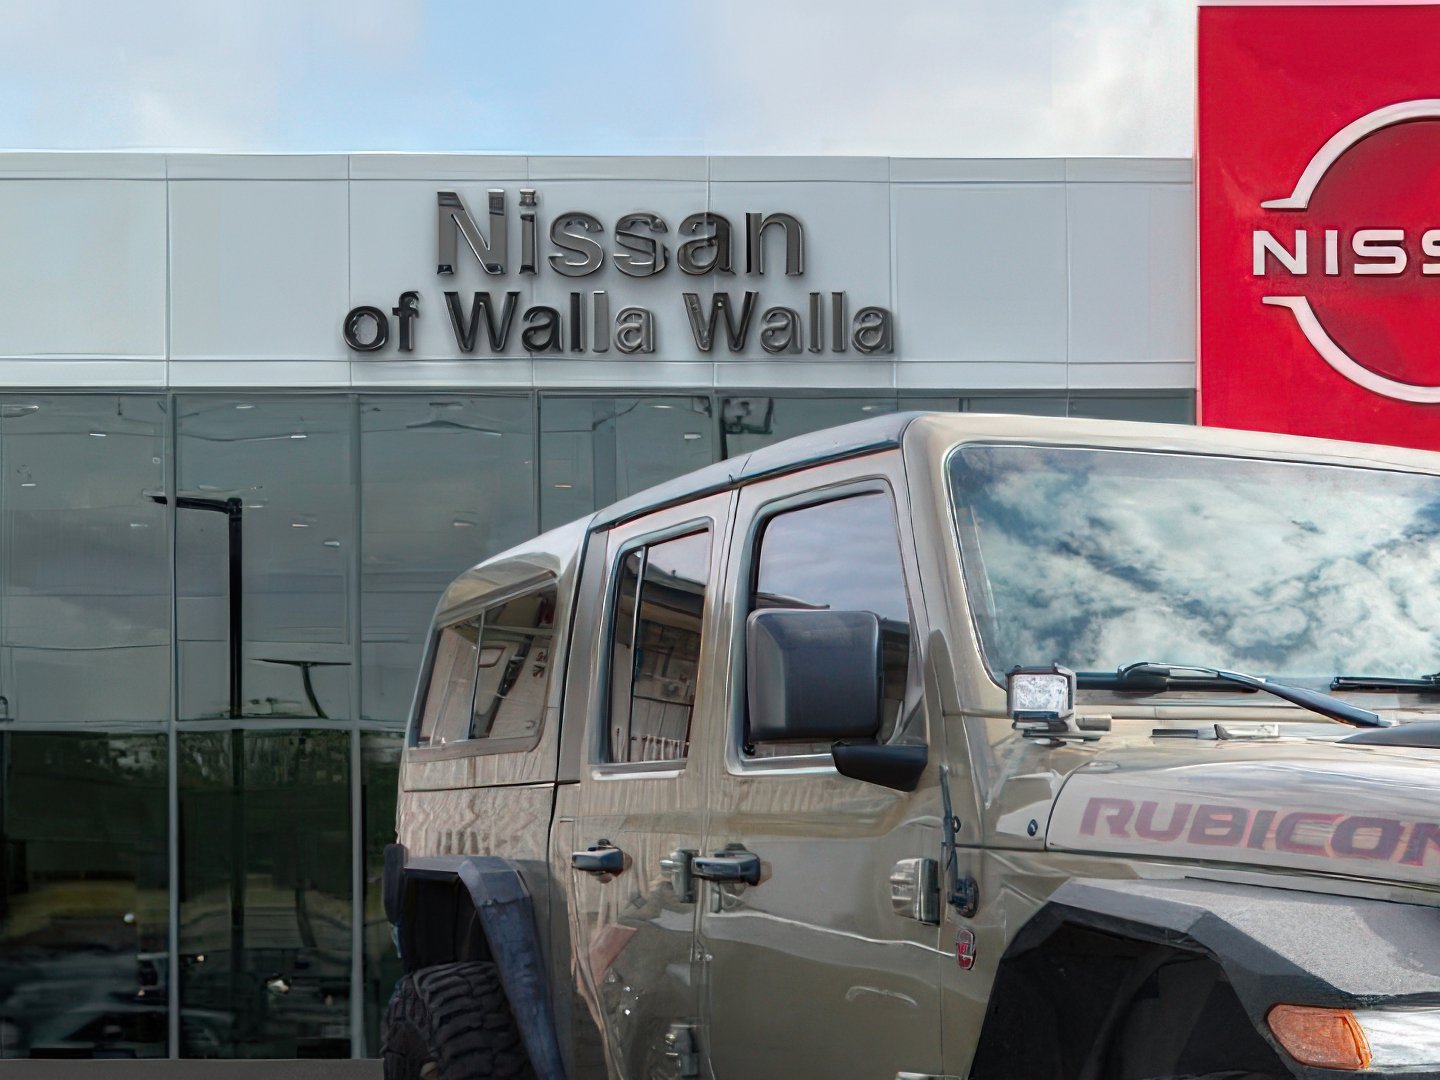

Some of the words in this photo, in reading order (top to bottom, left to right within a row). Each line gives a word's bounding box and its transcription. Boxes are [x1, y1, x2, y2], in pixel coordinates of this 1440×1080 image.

[436, 188, 804, 276] Nissan
[343, 291, 420, 353] of
[444, 291, 657, 354] Walla
[682, 291, 894, 354] Walla
